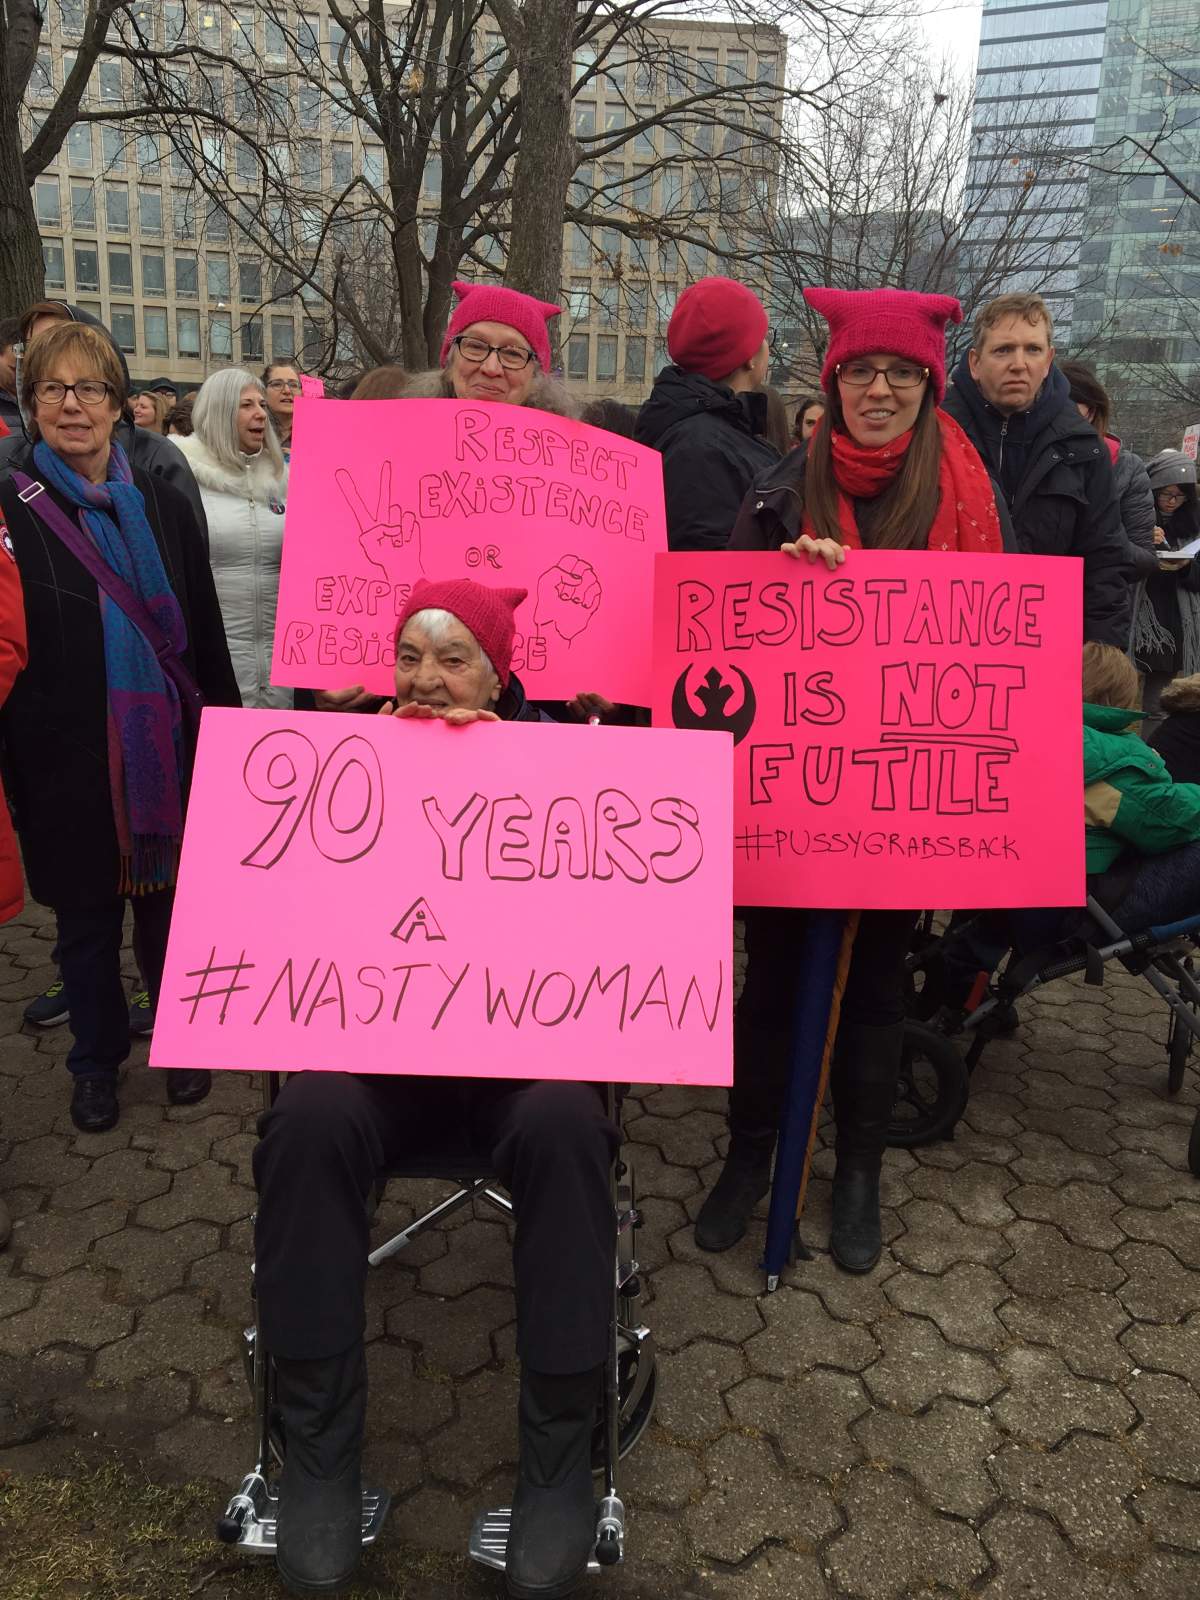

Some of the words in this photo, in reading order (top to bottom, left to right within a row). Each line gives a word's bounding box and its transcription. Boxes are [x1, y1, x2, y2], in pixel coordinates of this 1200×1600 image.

[454, 408, 638, 490] RESPECT
[418, 470, 649, 542] EXISTENCE
[464, 544, 503, 570] OR
[676, 578, 1045, 652] RESISTANCE
[784, 671, 846, 727] IS
[880, 661, 1026, 731] NOT
[239, 728, 385, 870] 90
[421, 787, 704, 884] YEARS
[748, 743, 1011, 816] FUTILE
[735, 823, 1020, 861] #PUSSYGRABSBACK
[389, 896, 447, 944] A
[179, 945, 723, 1033] #NASTYWOMAN
